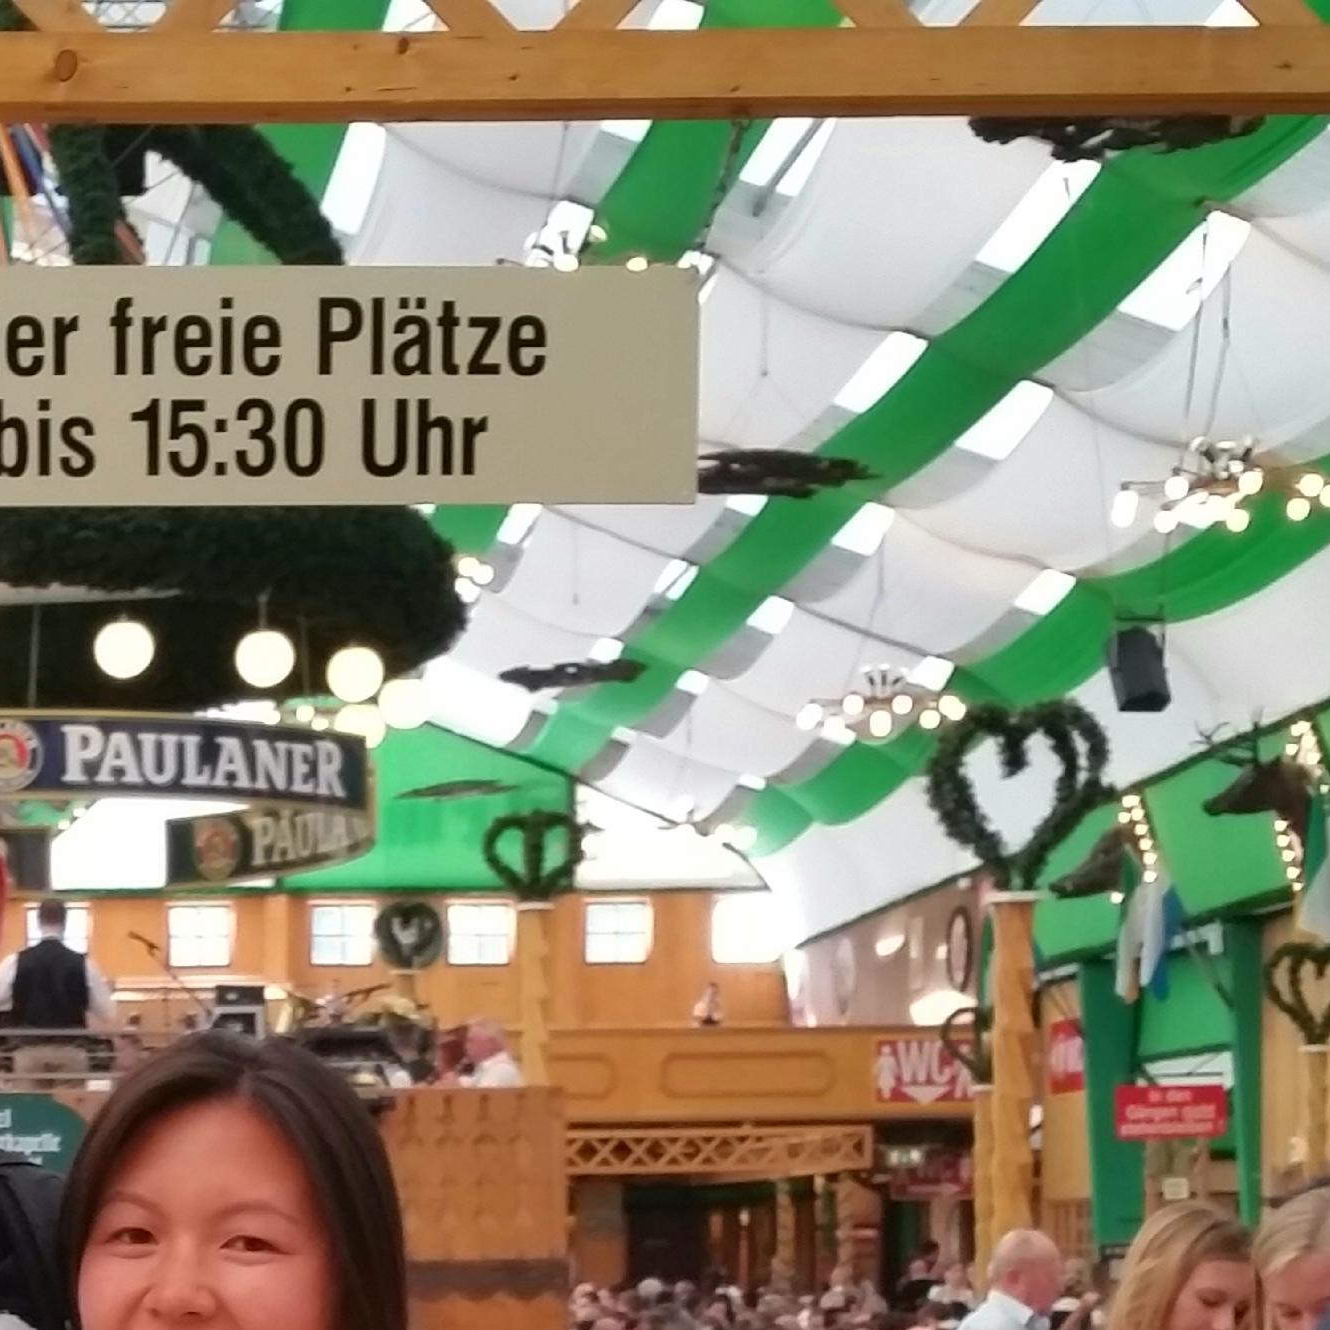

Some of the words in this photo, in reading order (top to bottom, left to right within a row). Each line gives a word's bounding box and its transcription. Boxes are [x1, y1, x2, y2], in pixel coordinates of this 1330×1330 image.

[108, 296, 283, 378] freie
[317, 295, 548, 378] Plätze
[129, 397, 326, 479] 15:30
[360, 397, 490, 479] Uhr
[60, 723, 347, 797] PAULANER
[896, 1040, 952, 1084] WC
